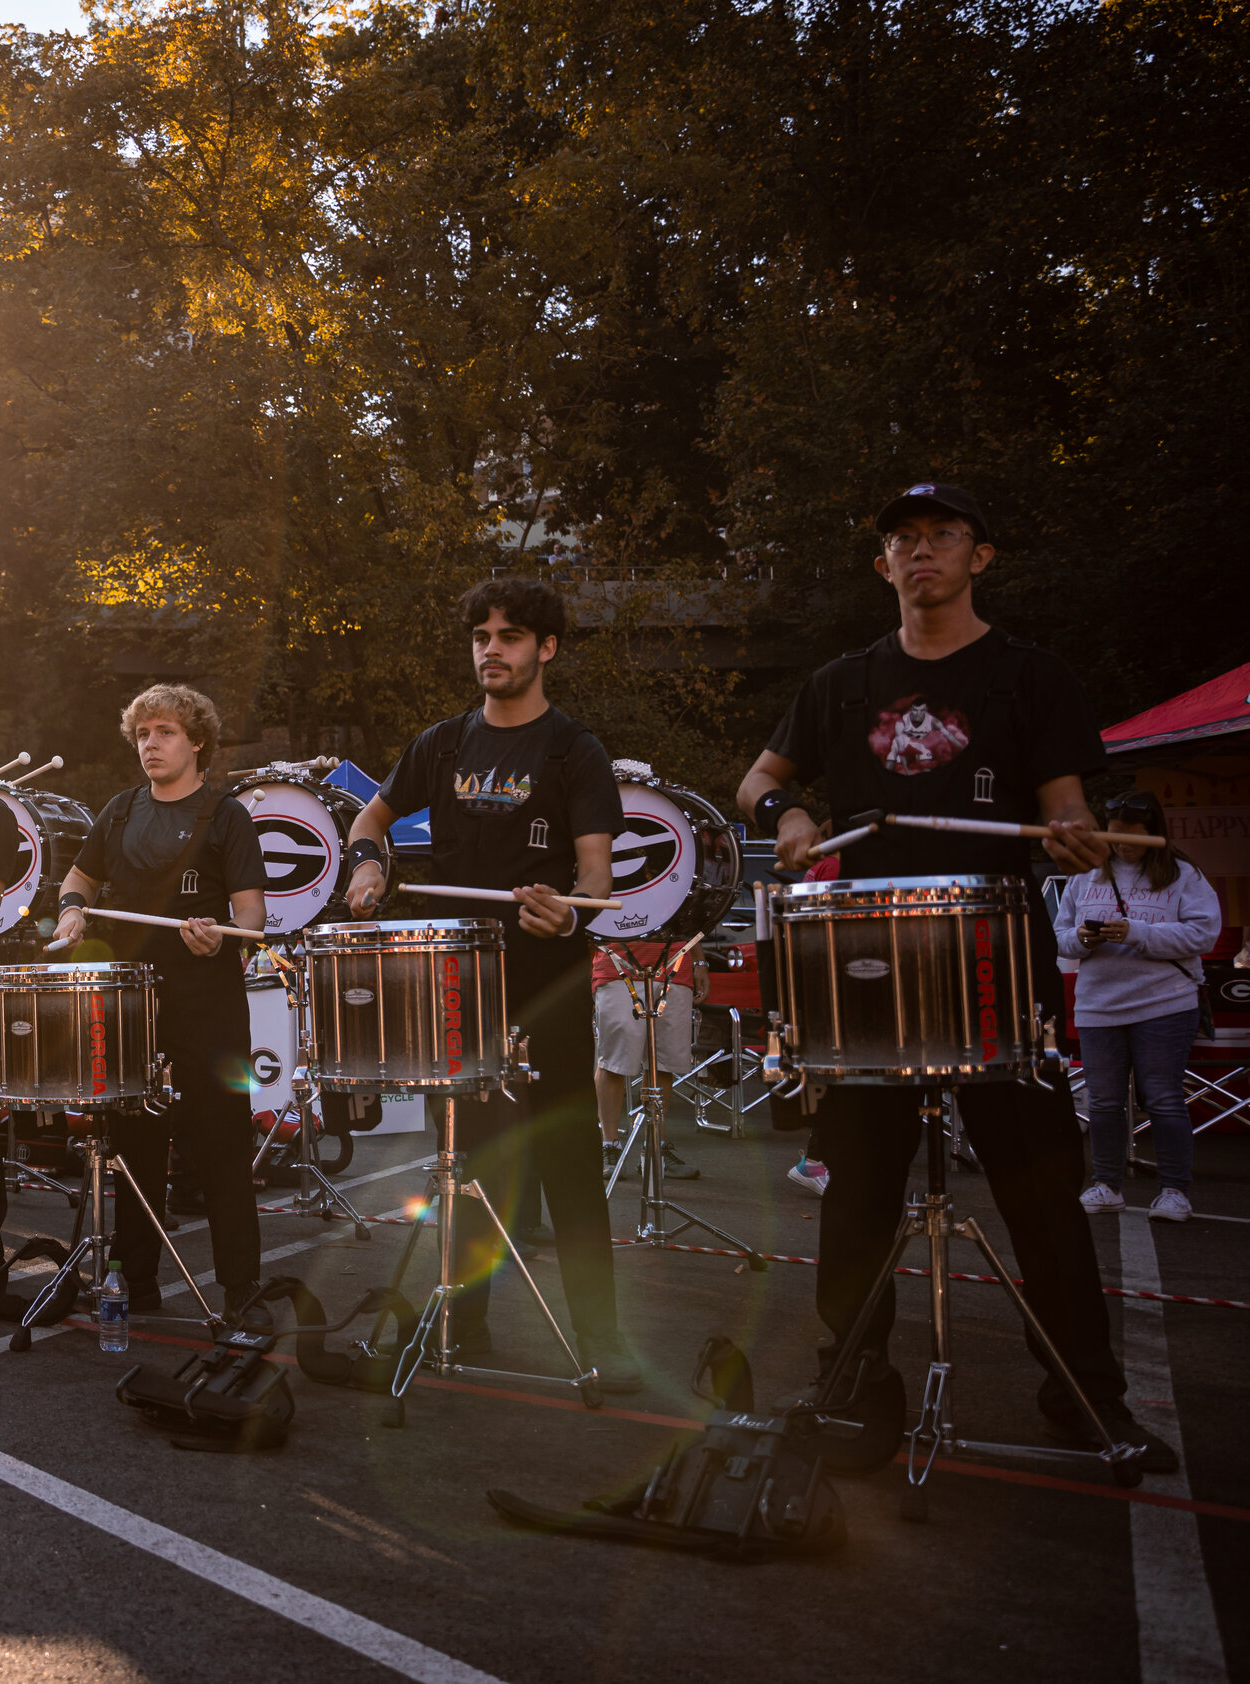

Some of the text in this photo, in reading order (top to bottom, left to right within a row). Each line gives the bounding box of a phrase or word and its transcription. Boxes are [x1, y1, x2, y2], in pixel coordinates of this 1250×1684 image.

[1168, 815, 1250, 840] HAPPY
[1084, 887, 1176, 904] UNIVERSITY
[620, 919, 645, 928] REMO
[1097, 909, 1166, 924] GERGIA
[974, 919, 998, 1063] GEORGIA
[444, 956, 463, 1076] GEORGIA
[90, 994, 107, 1096] GEORGIA
[250, 1049, 281, 1085] G
[380, 1093, 415, 1103] CYCLE
[229, 1331, 263, 1345] Pearl
